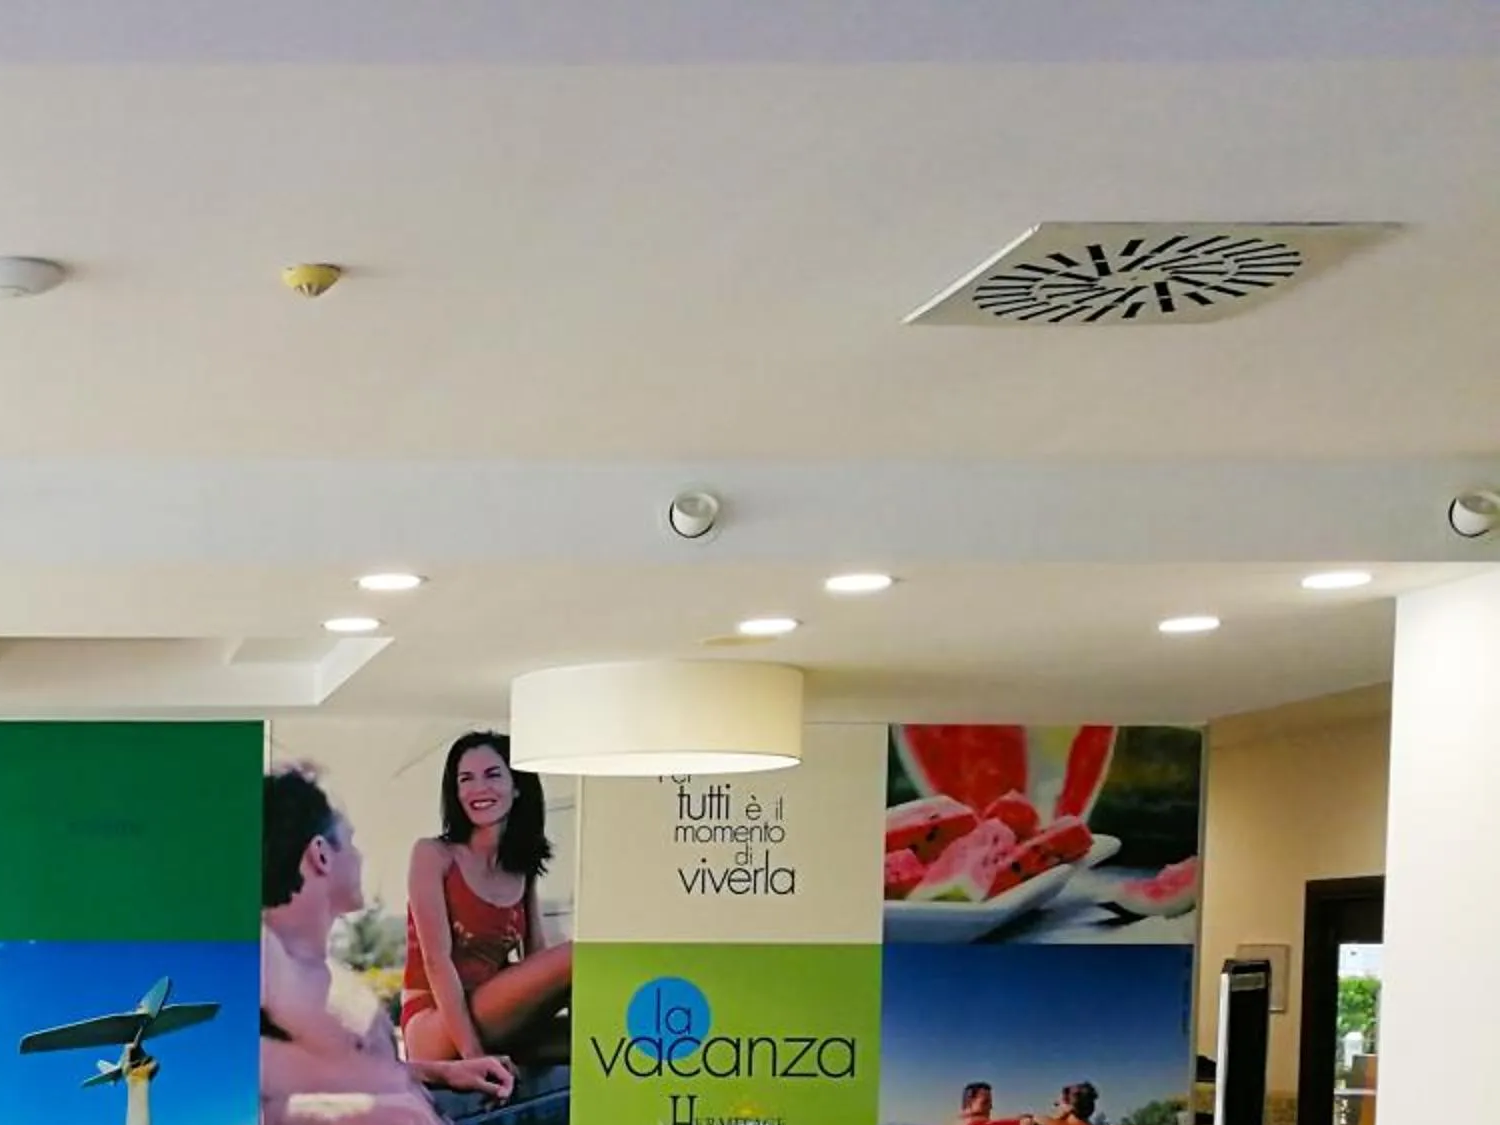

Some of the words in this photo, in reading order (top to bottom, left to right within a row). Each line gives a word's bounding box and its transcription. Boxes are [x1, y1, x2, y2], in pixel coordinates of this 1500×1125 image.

[676, 783, 731, 821] tutti
[745, 795, 763, 821] è
[775, 796, 784, 821] il
[674, 823, 786, 844] momento
[677, 849, 796, 895] viverla
[734, 845, 753, 867] di
[654, 987, 692, 1035] la
[590, 1036, 857, 1079] vacanza
